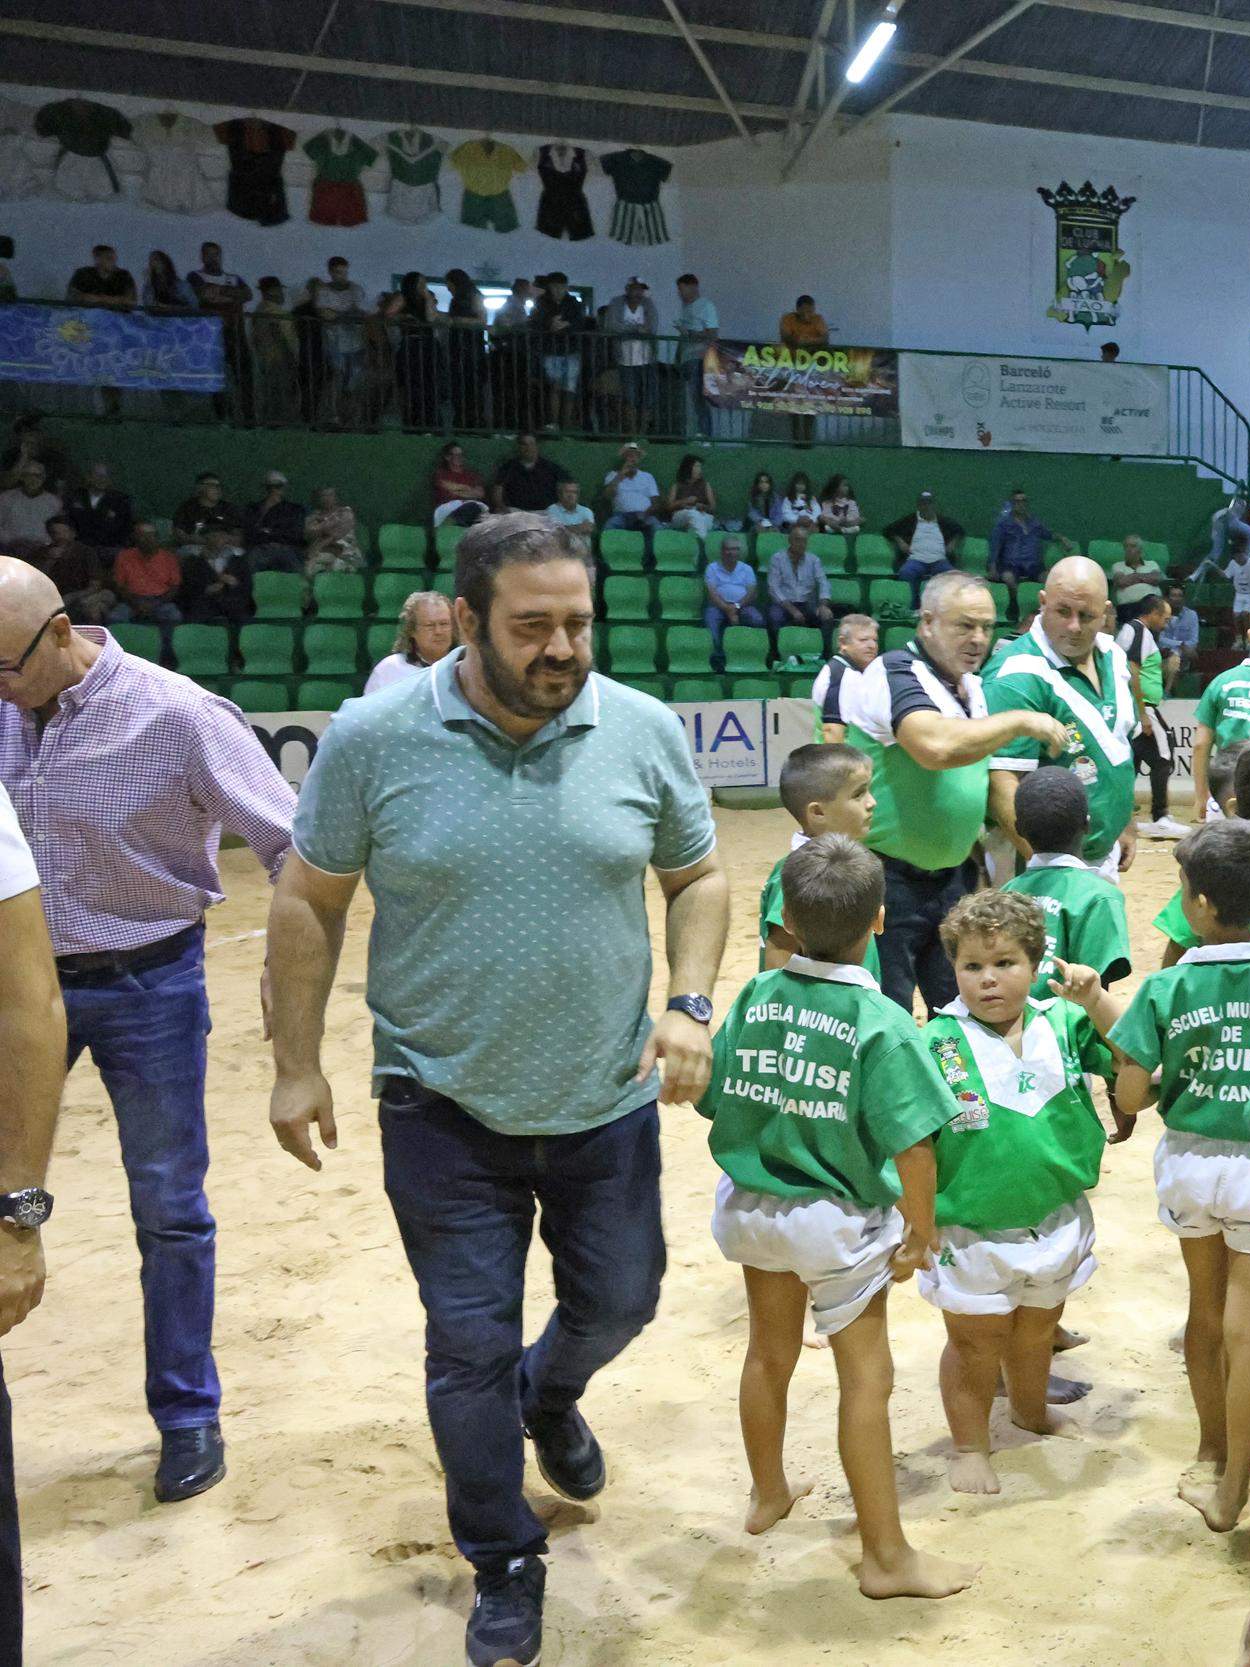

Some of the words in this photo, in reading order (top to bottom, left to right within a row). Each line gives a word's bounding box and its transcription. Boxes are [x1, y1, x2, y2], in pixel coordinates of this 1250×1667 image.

[1072, 300, 1103, 311] TAO
[742, 345, 850, 373] ASADOR
[999, 364, 1052, 379] Barceló
[999, 378, 1067, 394] Lanzarote
[999, 395, 1042, 410] Active
[1044, 397, 1087, 412] Resort
[1113, 407, 1152, 418] ACTIVE
[708, 758, 757, 769] Hotels
[784, 1031, 807, 1054] DE
[1220, 1025, 1243, 1043] DE
[735, 1049, 851, 1097] TEUISE
[722, 1077, 782, 1105] LUCH
[780, 1096, 848, 1123] ANARIA
